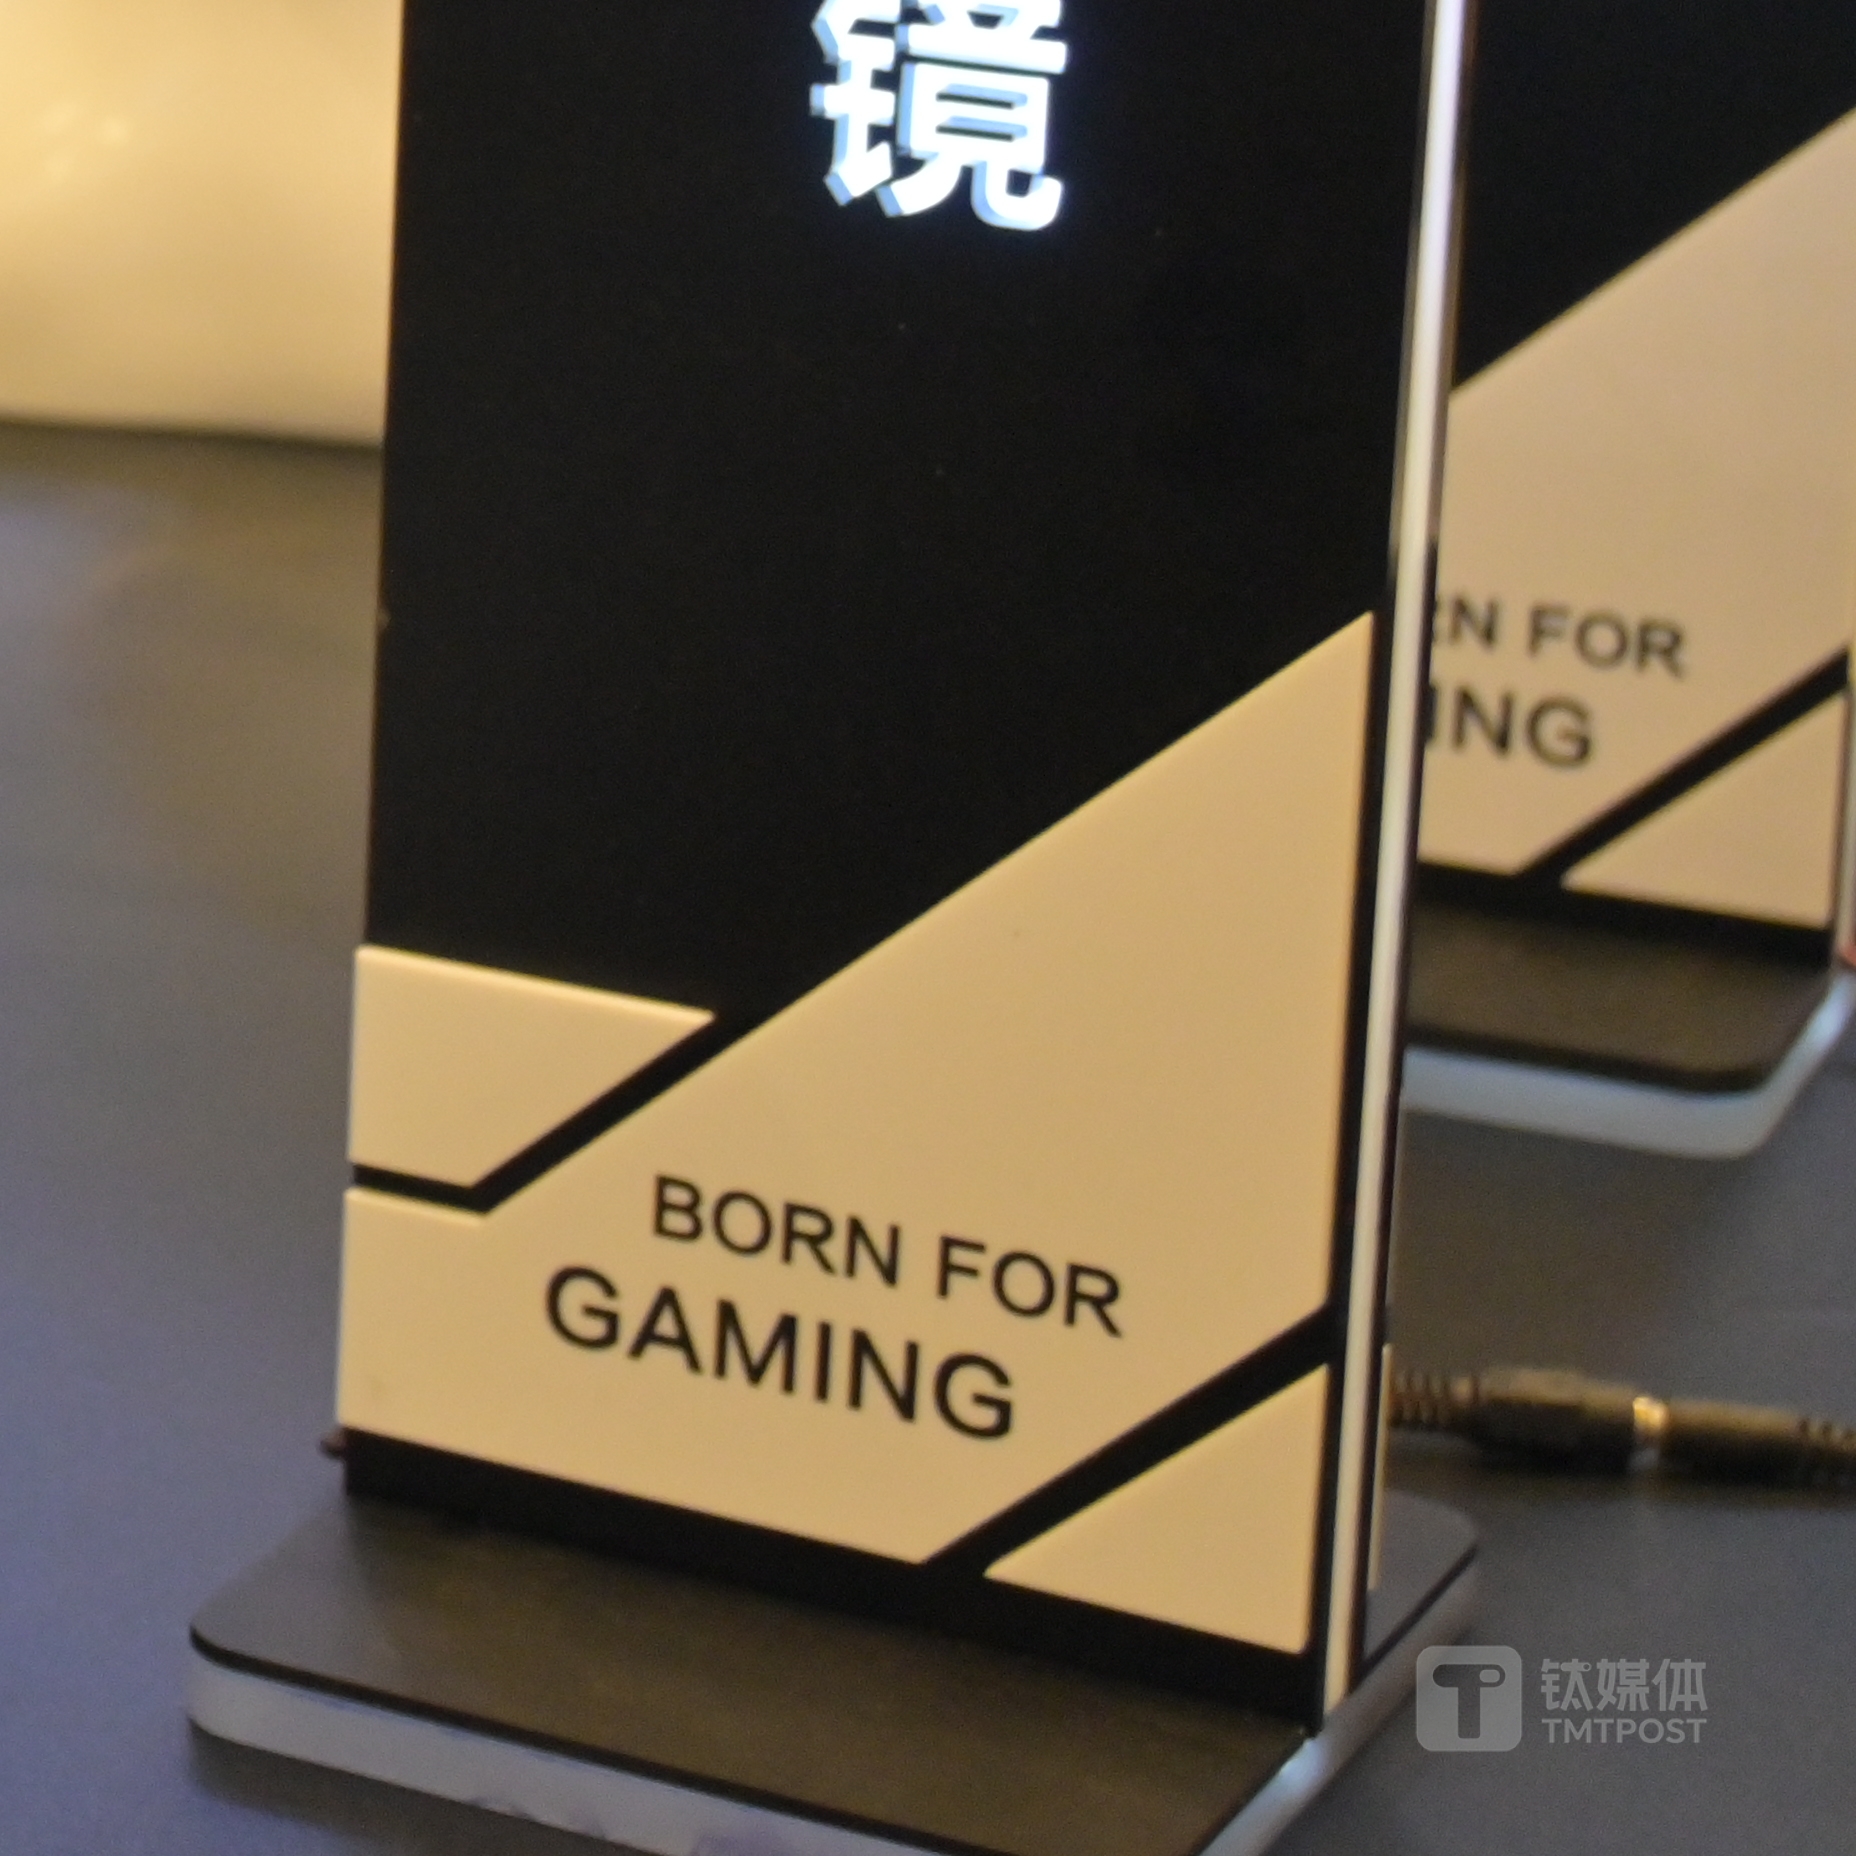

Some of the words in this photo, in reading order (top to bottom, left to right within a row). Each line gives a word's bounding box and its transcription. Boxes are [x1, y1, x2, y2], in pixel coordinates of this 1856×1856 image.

[1527, 600, 1687, 678] FOR
[651, 1173, 902, 1290] BORN
[936, 1234, 1124, 1338] FOR
[544, 1264, 1014, 1441] GAMING
